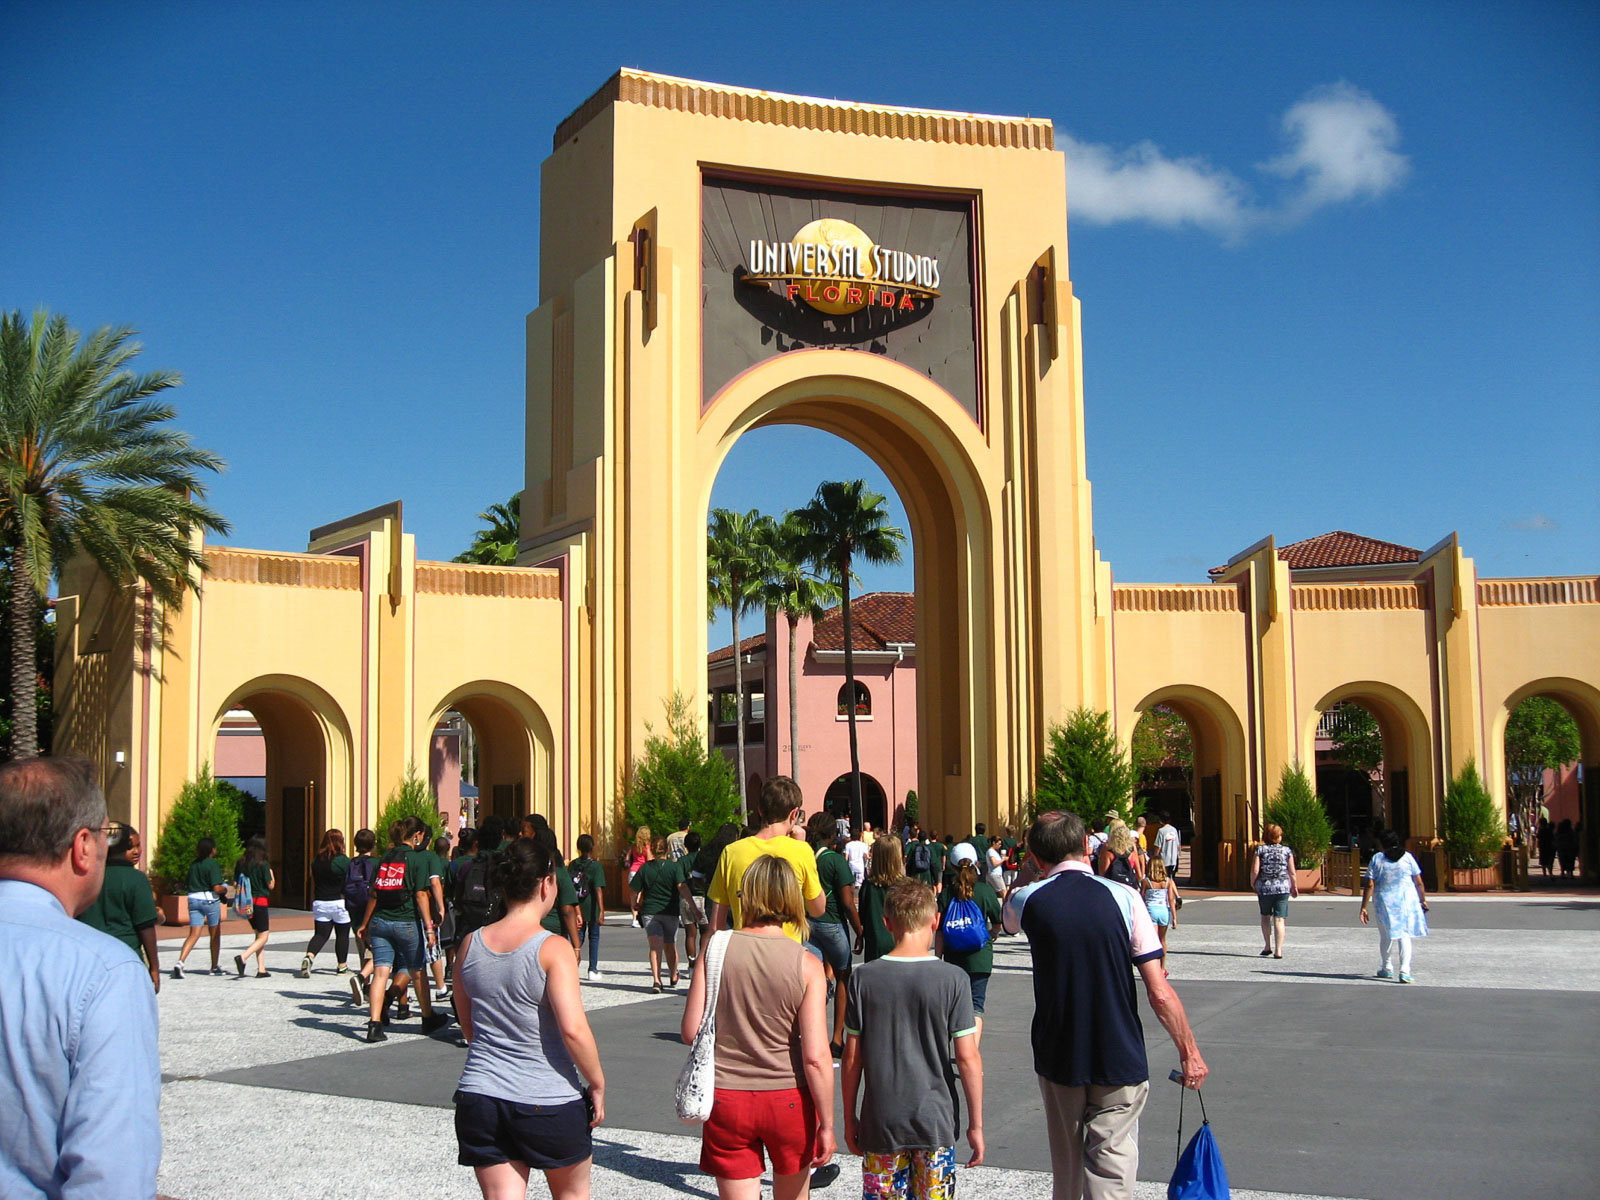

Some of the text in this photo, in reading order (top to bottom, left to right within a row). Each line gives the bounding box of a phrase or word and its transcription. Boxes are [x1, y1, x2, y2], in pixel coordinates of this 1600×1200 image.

[749, 239, 940, 289] UNIVERSAL STUDIOS
[786, 285, 915, 310] FLORIDA
